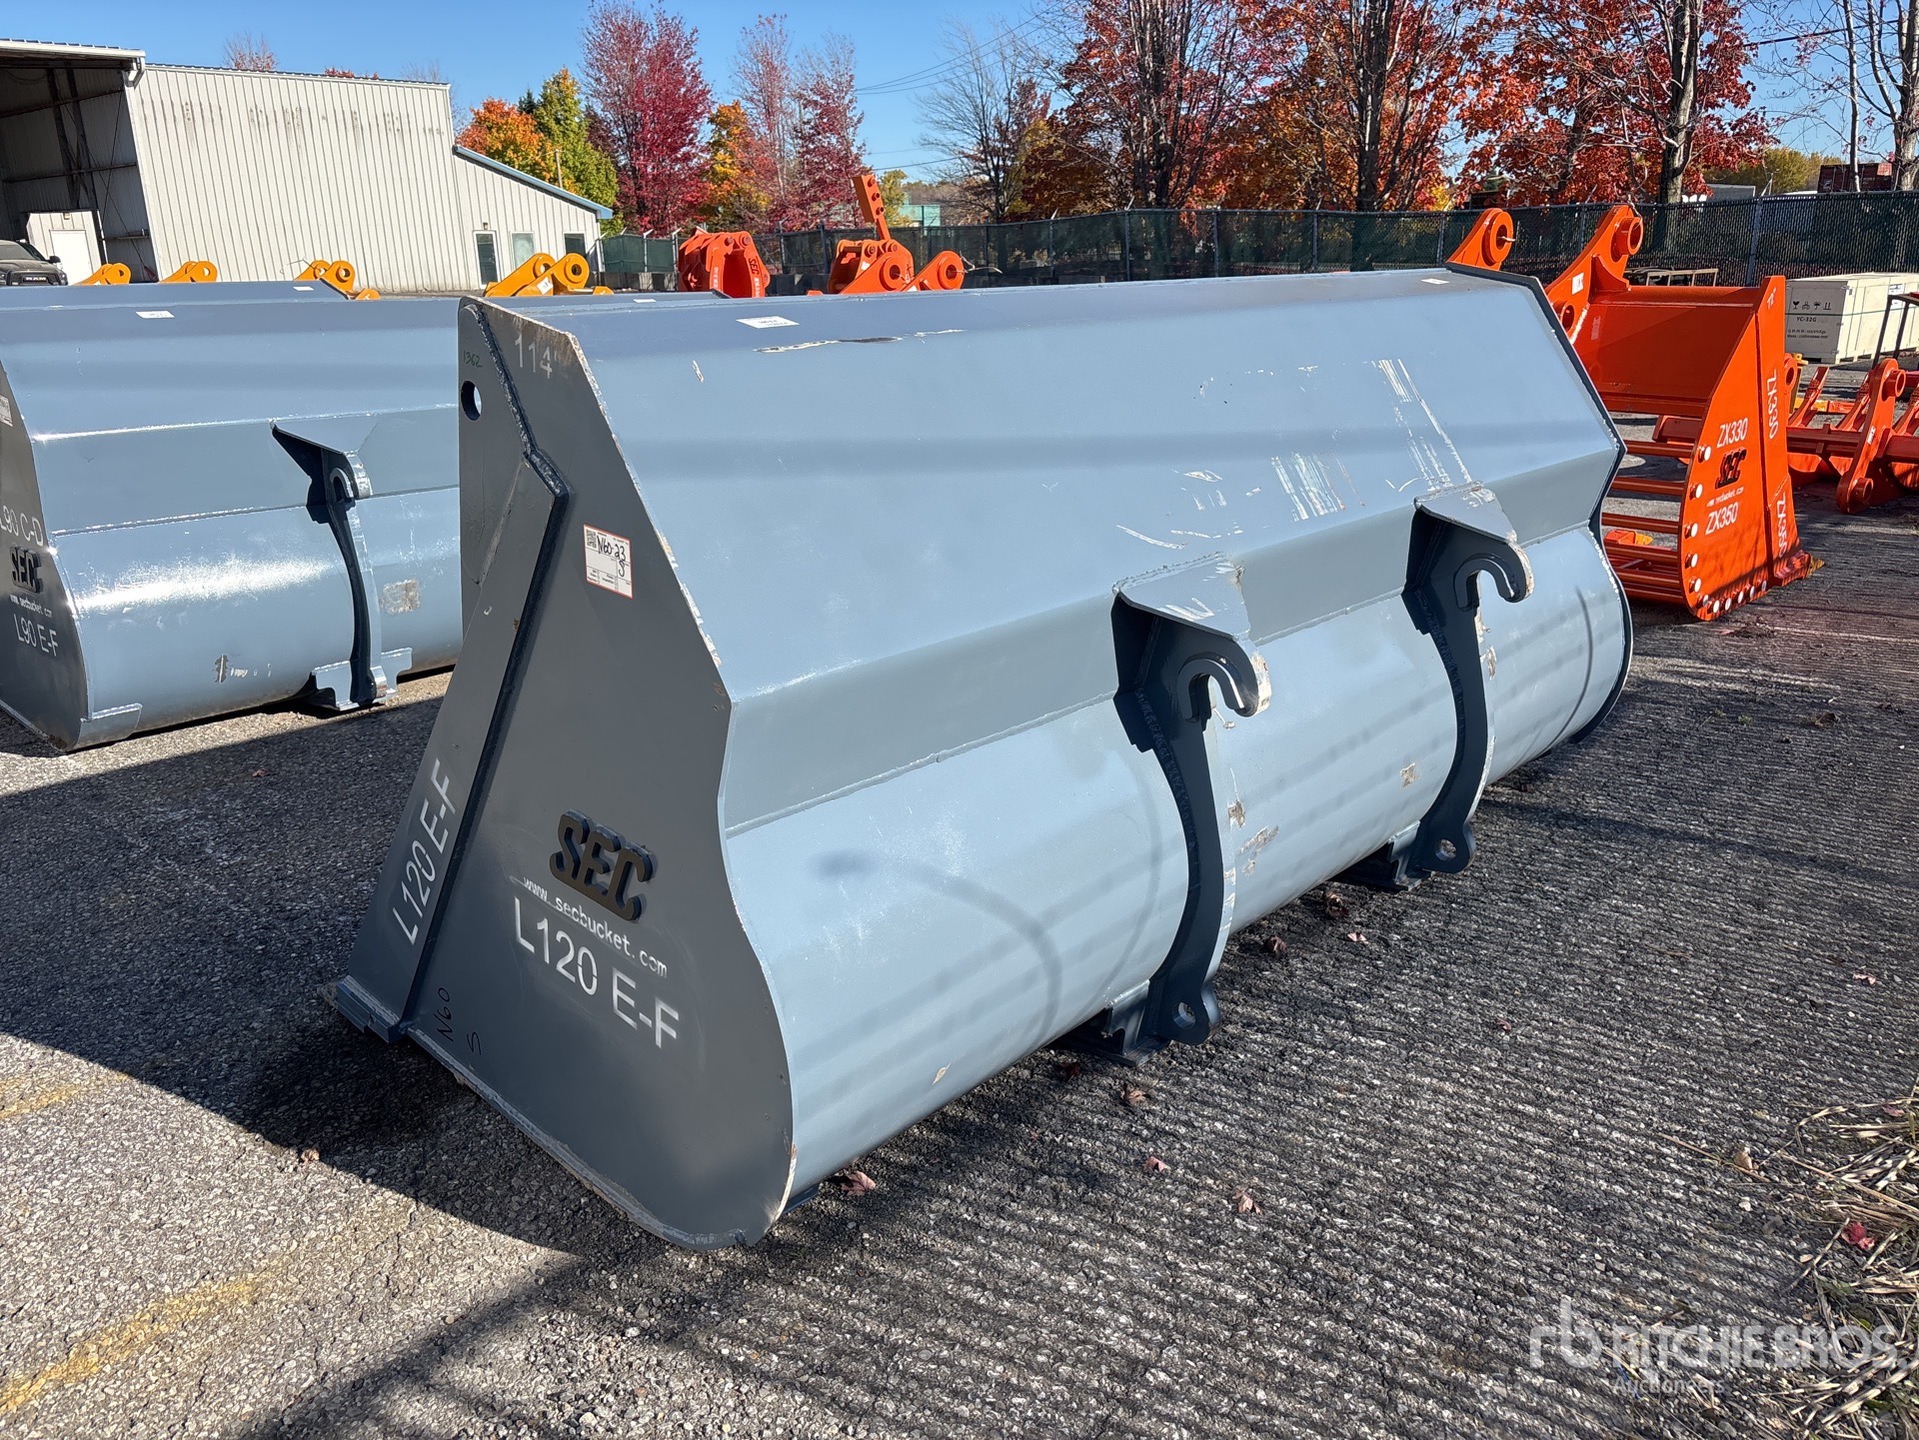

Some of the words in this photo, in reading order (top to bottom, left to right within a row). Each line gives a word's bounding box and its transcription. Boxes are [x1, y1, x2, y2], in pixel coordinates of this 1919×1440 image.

[1766, 368, 1780, 440] ZX330
[1716, 417, 1749, 449] ZX330
[1715, 447, 1748, 490] SEC
[20, 512, 44, 547] C-D
[1704, 501, 1739, 536] ZX350
[1776, 491, 1789, 559] ZX350
[10, 546, 43, 594] SEC
[13, 613, 37, 648] L90
[37, 623, 59, 657] E-F
[392, 839, 436, 945] L120
[420, 757, 456, 854] E-F
[549, 808, 656, 923] SEC
[514, 896, 598, 996] L120
[612, 967, 680, 1049] E-F
[432, 987, 454, 1042] N60
